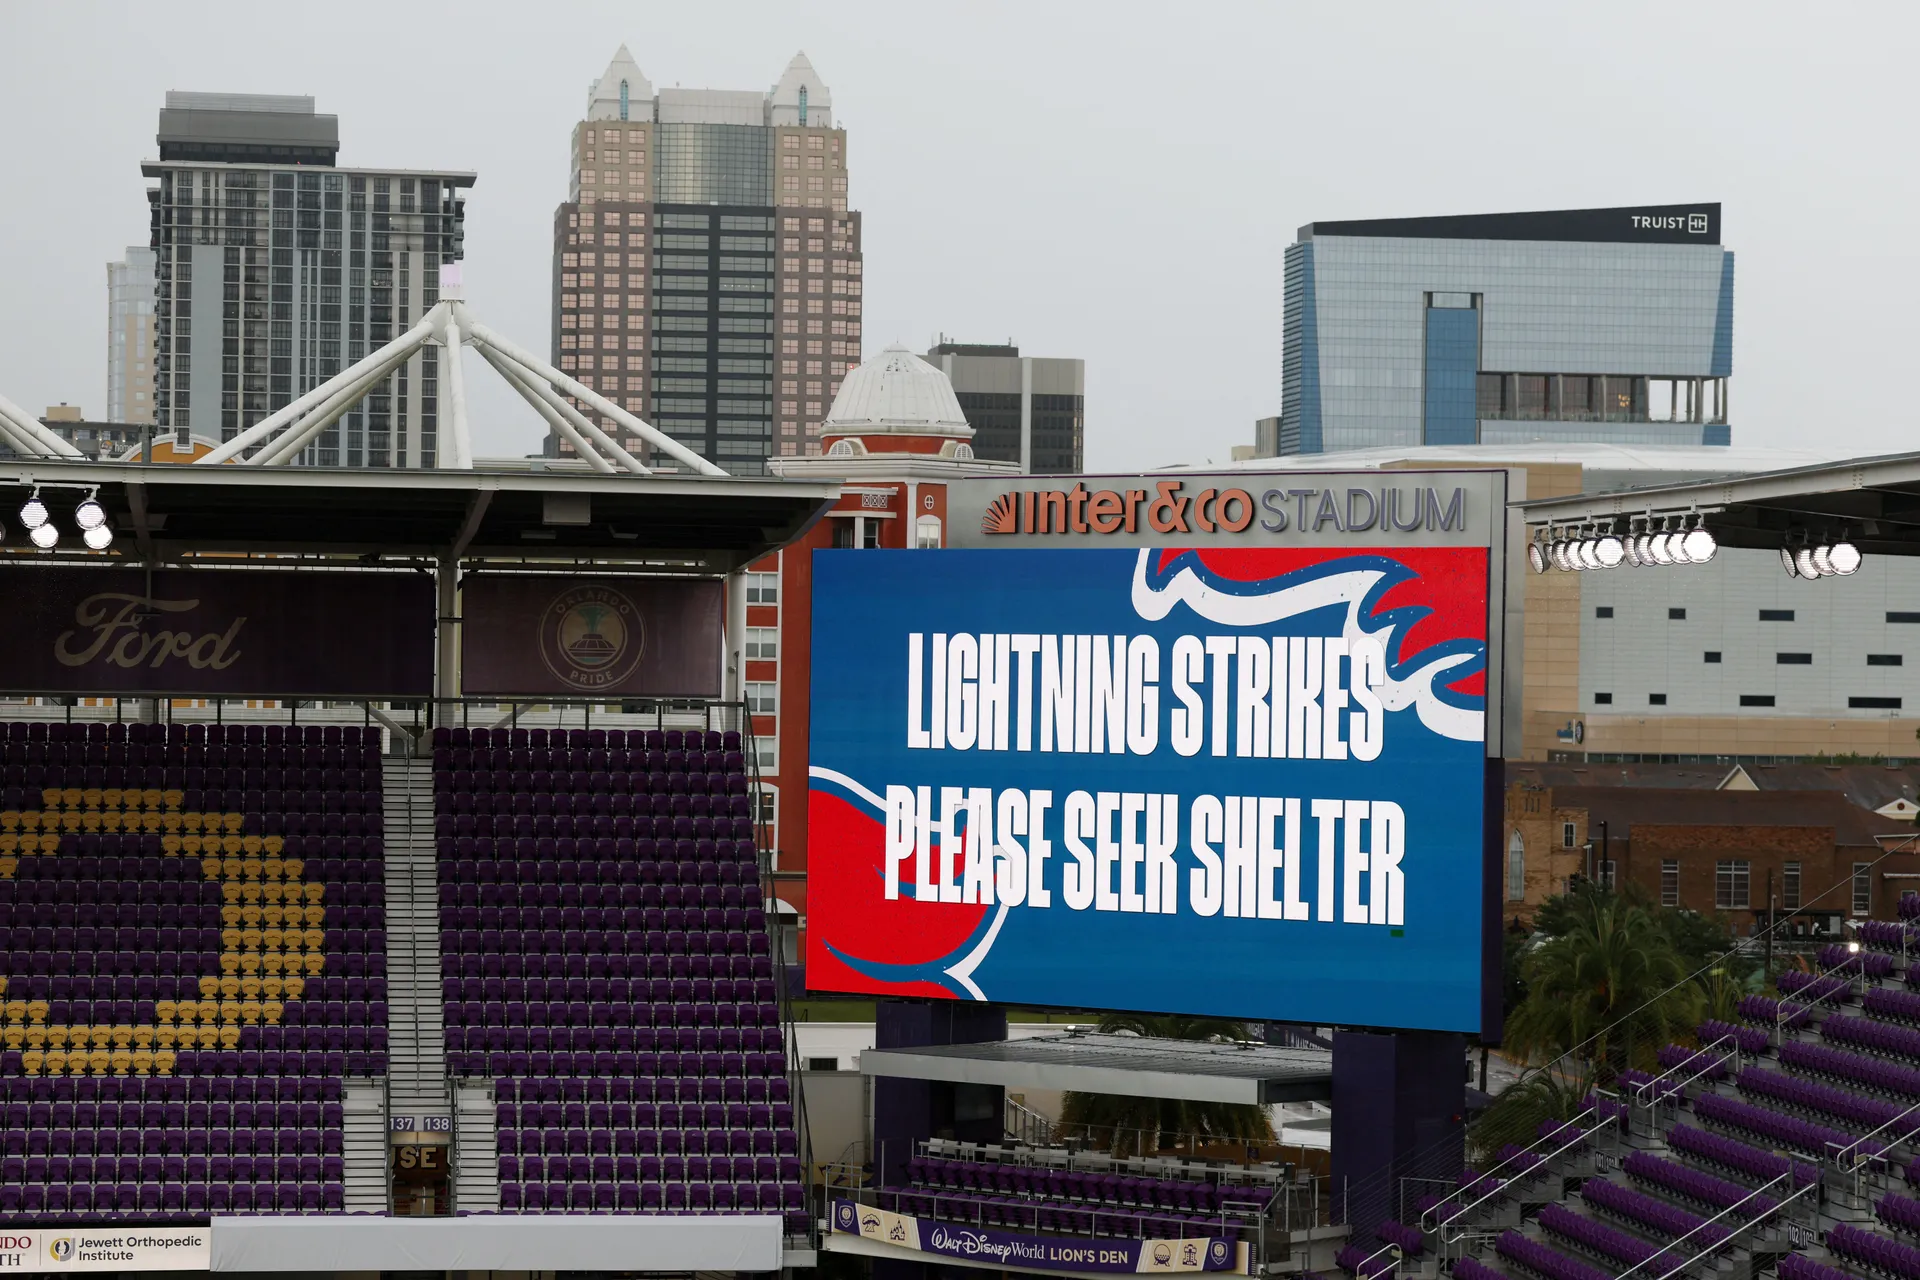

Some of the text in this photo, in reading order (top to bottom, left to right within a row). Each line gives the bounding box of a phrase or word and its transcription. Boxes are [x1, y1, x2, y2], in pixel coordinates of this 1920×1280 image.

[1631, 216, 1685, 229] TRUIST
[1260, 487, 1465, 532] STADIUM
[555, 590, 630, 614] ORLANDO
[54, 592, 247, 670] Ford
[569, 670, 614, 684] PRIDE
[908, 632, 1384, 762] LIGHTNING STRIKES
[885, 784, 1405, 926] PLEASE SEEK SHELTER
[389, 1118, 413, 1130] 137
[425, 1118, 449, 1130] 138
[0, 1236, 32, 1249] DO
[79, 1235, 202, 1250] Jewett Orthopedic
[1788, 1225, 1799, 1244] 102
[79, 1250, 134, 1261] Institute
[1010, 1241, 1045, 1260] World
[1050, 1248, 1096, 1263] LION'S
[1099, 1250, 1128, 1264] DEN
